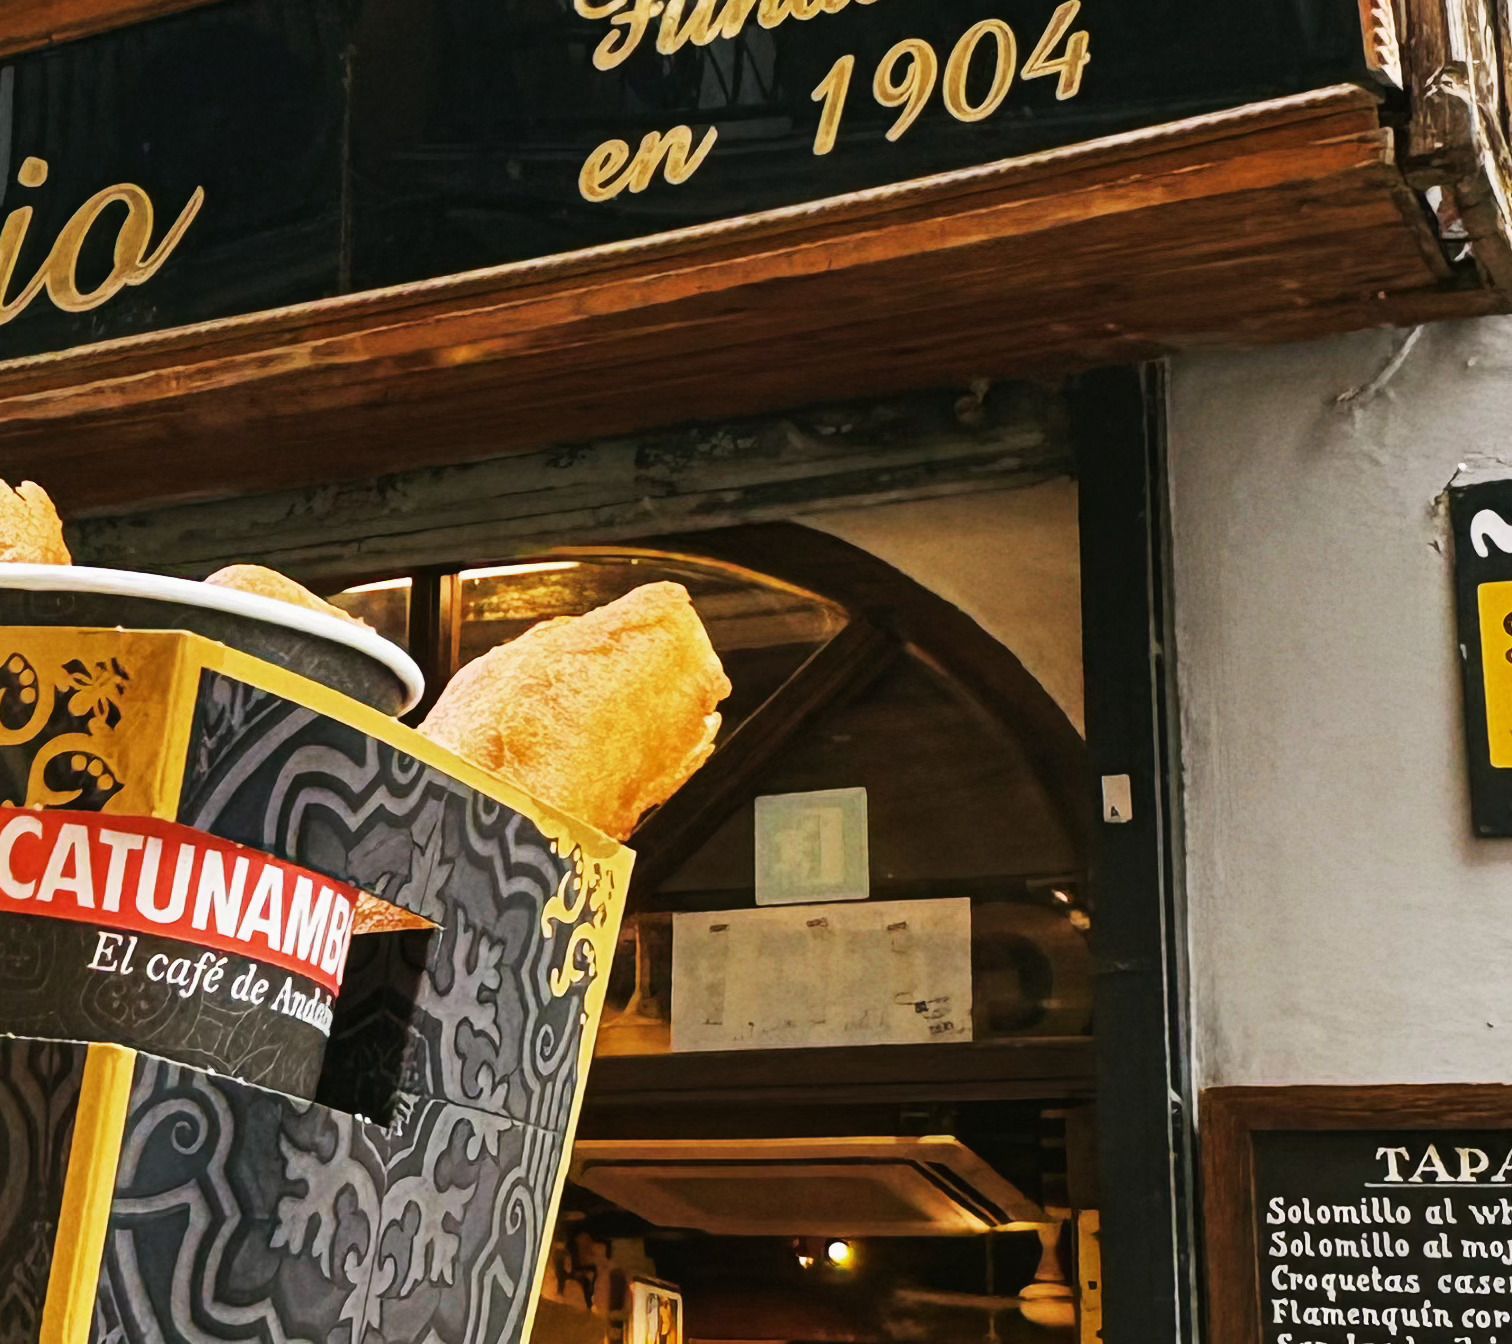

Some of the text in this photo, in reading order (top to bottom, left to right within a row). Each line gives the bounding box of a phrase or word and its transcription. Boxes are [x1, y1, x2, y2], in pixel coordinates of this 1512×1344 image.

[578, 125, 718, 202] en
[87, 930, 138, 976] El
[146, 951, 228, 998] café
[231, 963, 270, 1006] de
[1266, 1196, 1411, 1225] Solomillo
[1425, 1197, 1458, 1225] al
[1268, 1230, 1410, 1257] Solomillo
[1422, 1232, 1453, 1258] al
[1271, 1264, 1512, 1302] Croquetas case
[1271, 1298, 1454, 1336] Flamenquín
